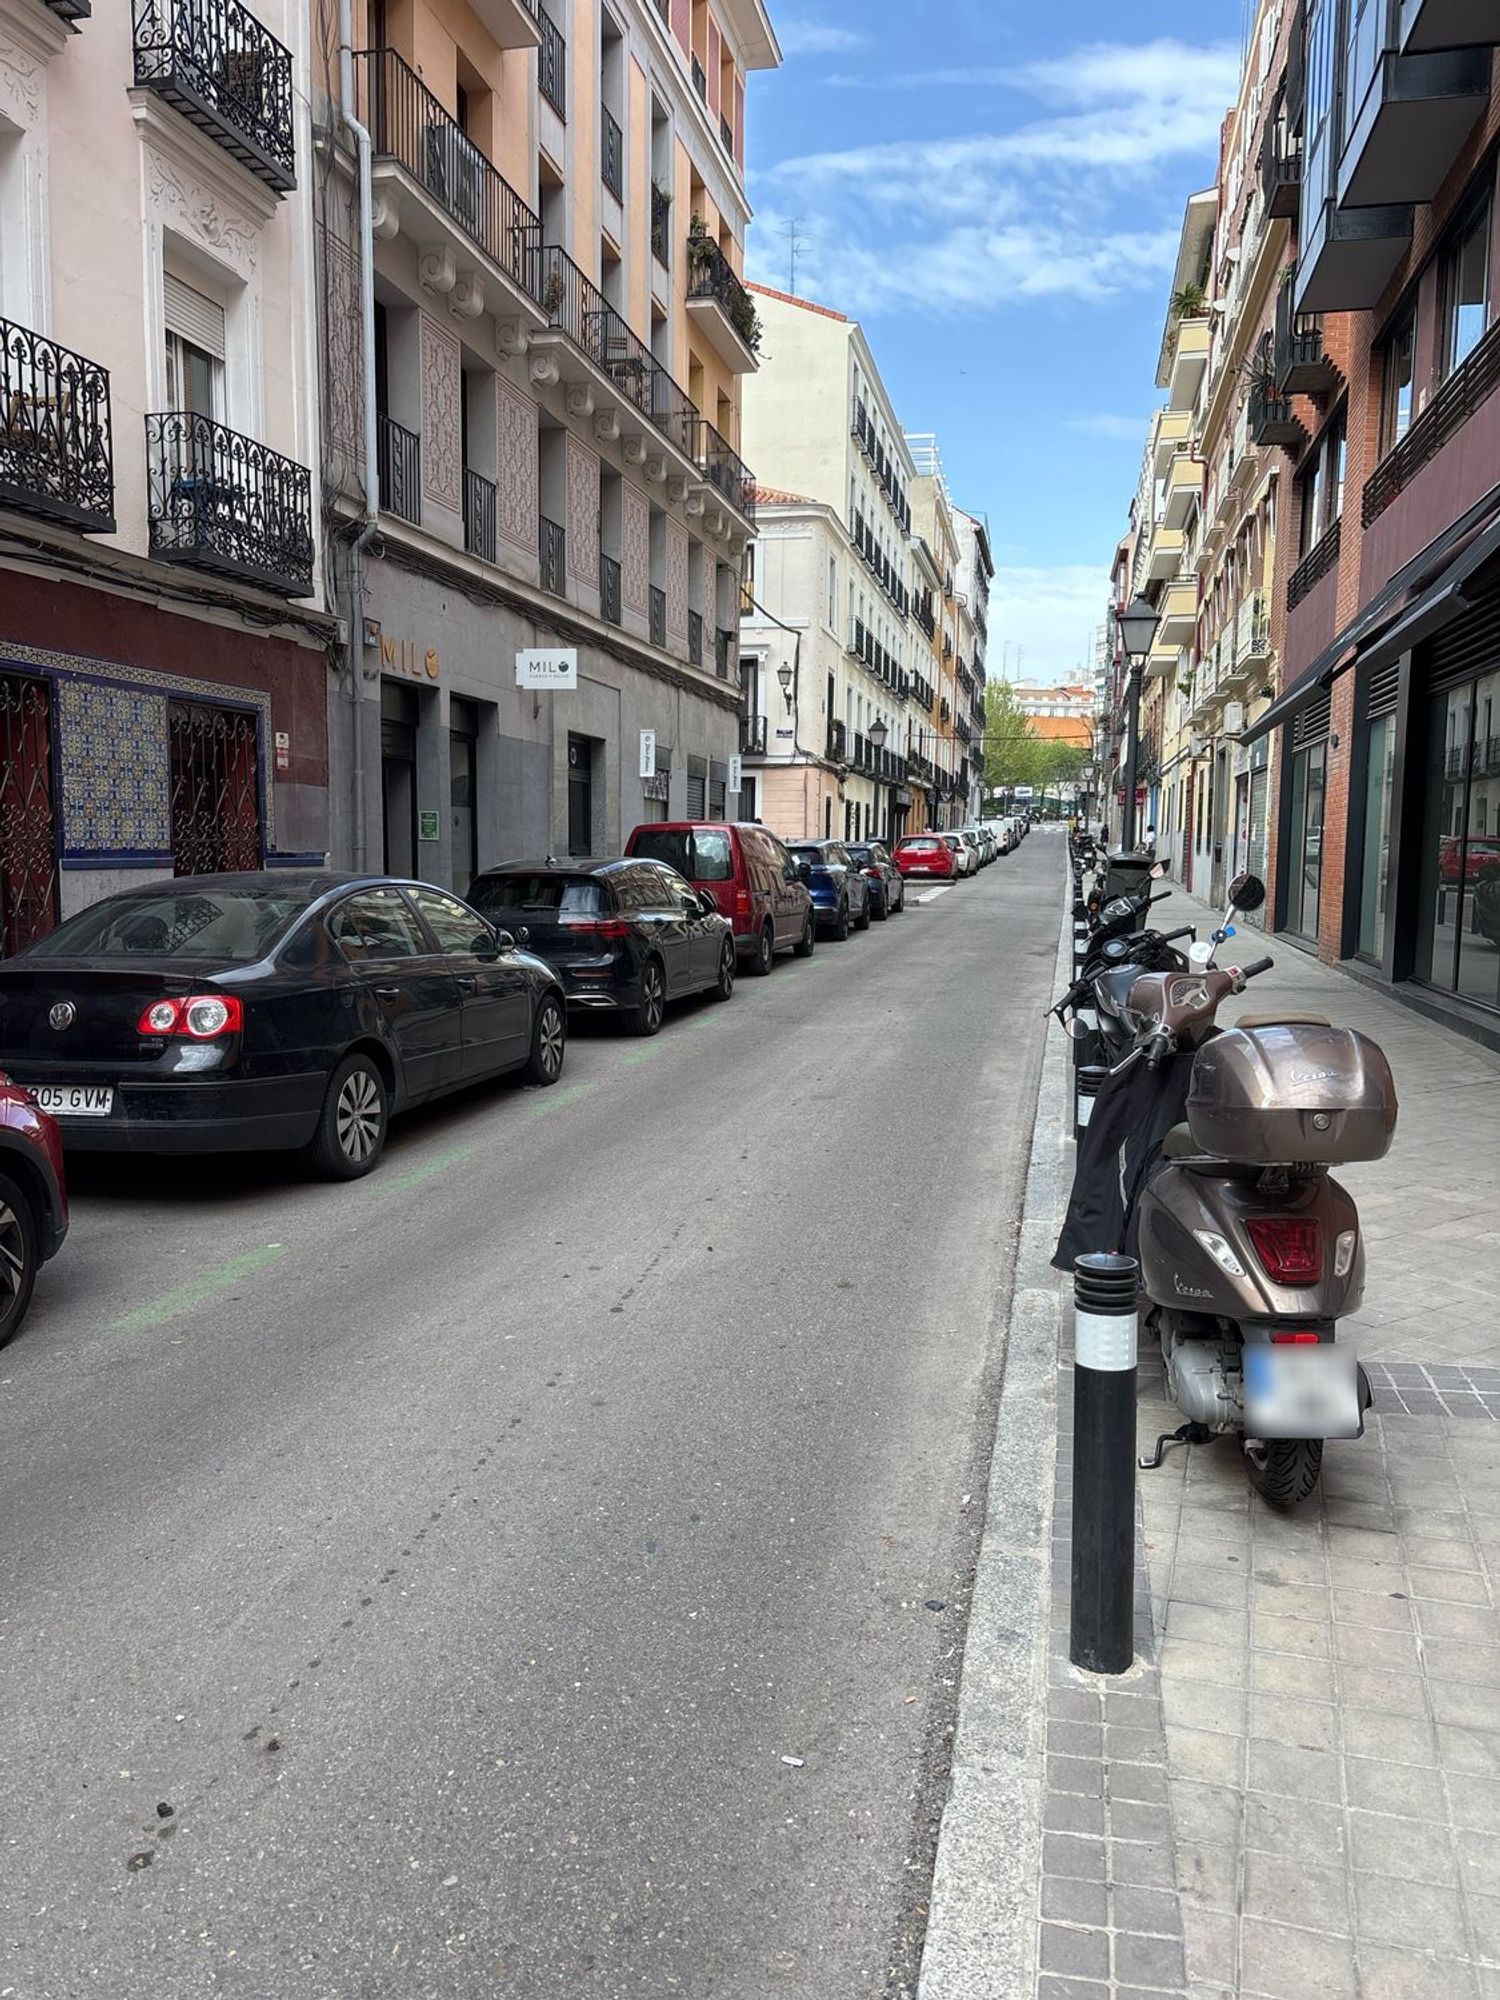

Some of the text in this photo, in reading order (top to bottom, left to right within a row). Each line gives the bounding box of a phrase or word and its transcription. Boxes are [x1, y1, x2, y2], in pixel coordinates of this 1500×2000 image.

[529, 661, 569, 673] MILO
[1290, 1070, 1342, 1087] Vespa
[70, 1089, 107, 1109] GVM
[1174, 1271, 1215, 1299] Vespa
